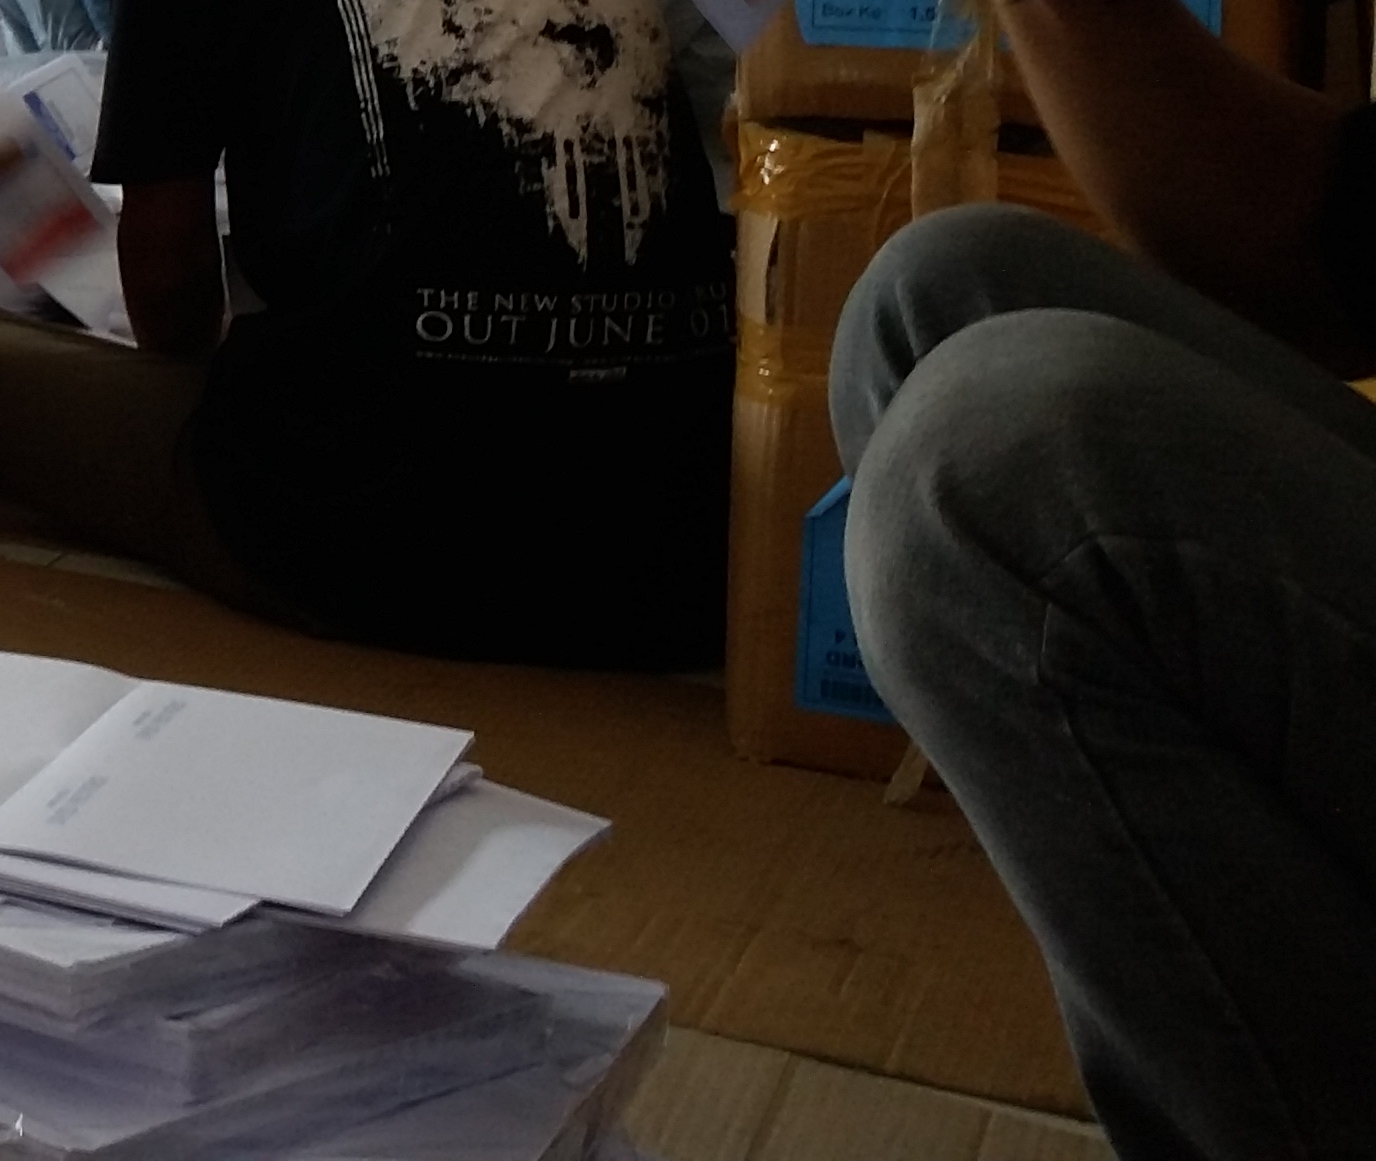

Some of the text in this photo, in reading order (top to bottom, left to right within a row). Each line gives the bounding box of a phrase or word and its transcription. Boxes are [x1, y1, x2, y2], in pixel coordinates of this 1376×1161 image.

[417, 287, 479, 311] THE
[494, 292, 558, 312] NEW
[569, 290, 675, 314] STUDIO
[416, 310, 528, 346] OUT
[545, 314, 664, 354] JUNE
